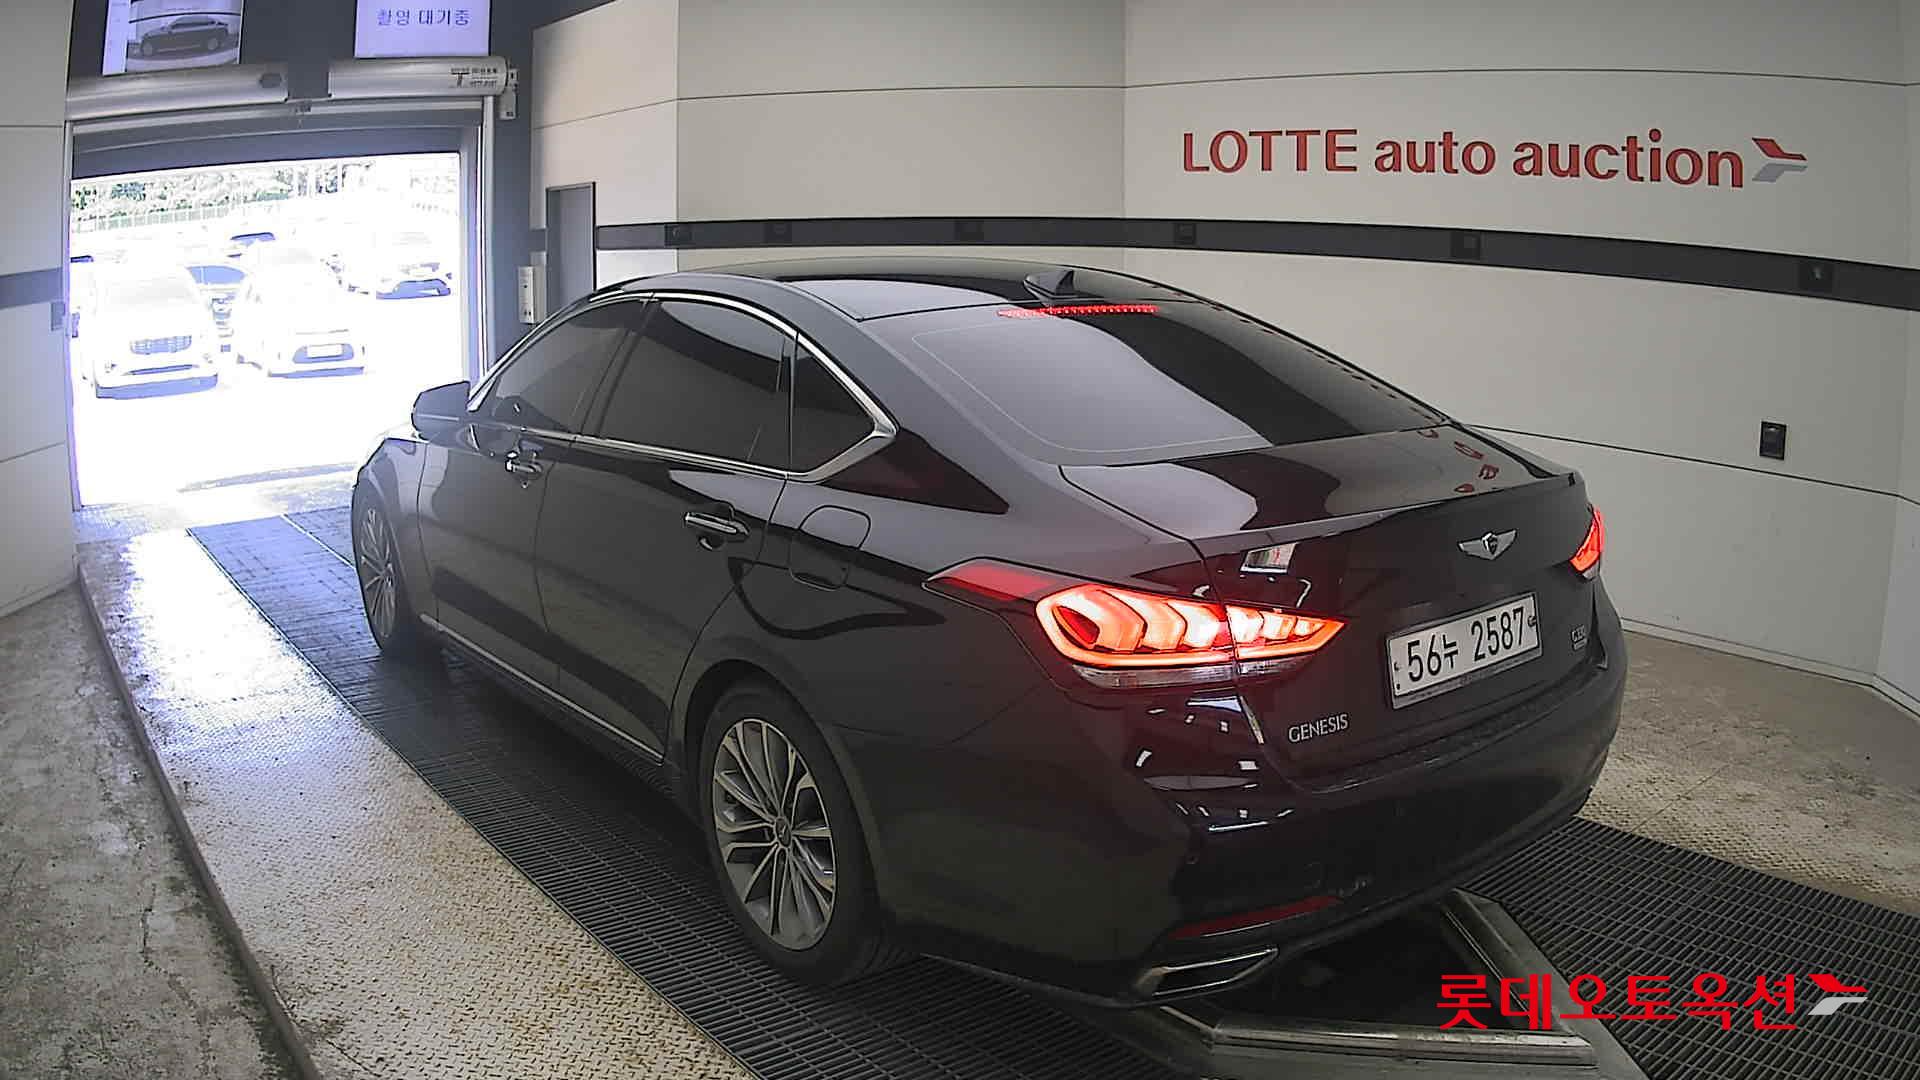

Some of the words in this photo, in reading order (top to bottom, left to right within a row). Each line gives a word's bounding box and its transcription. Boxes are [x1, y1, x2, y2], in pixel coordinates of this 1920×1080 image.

[418, 8, 471, 26] 대기중
[1183, 128, 1358, 172] LOTTE
[1374, 130, 1496, 176] auto
[1512, 128, 1744, 188] auction
[1406, 633, 1459, 683] 56누
[1471, 605, 1525, 662] 2587
[1288, 712, 1349, 743] GENESIS
